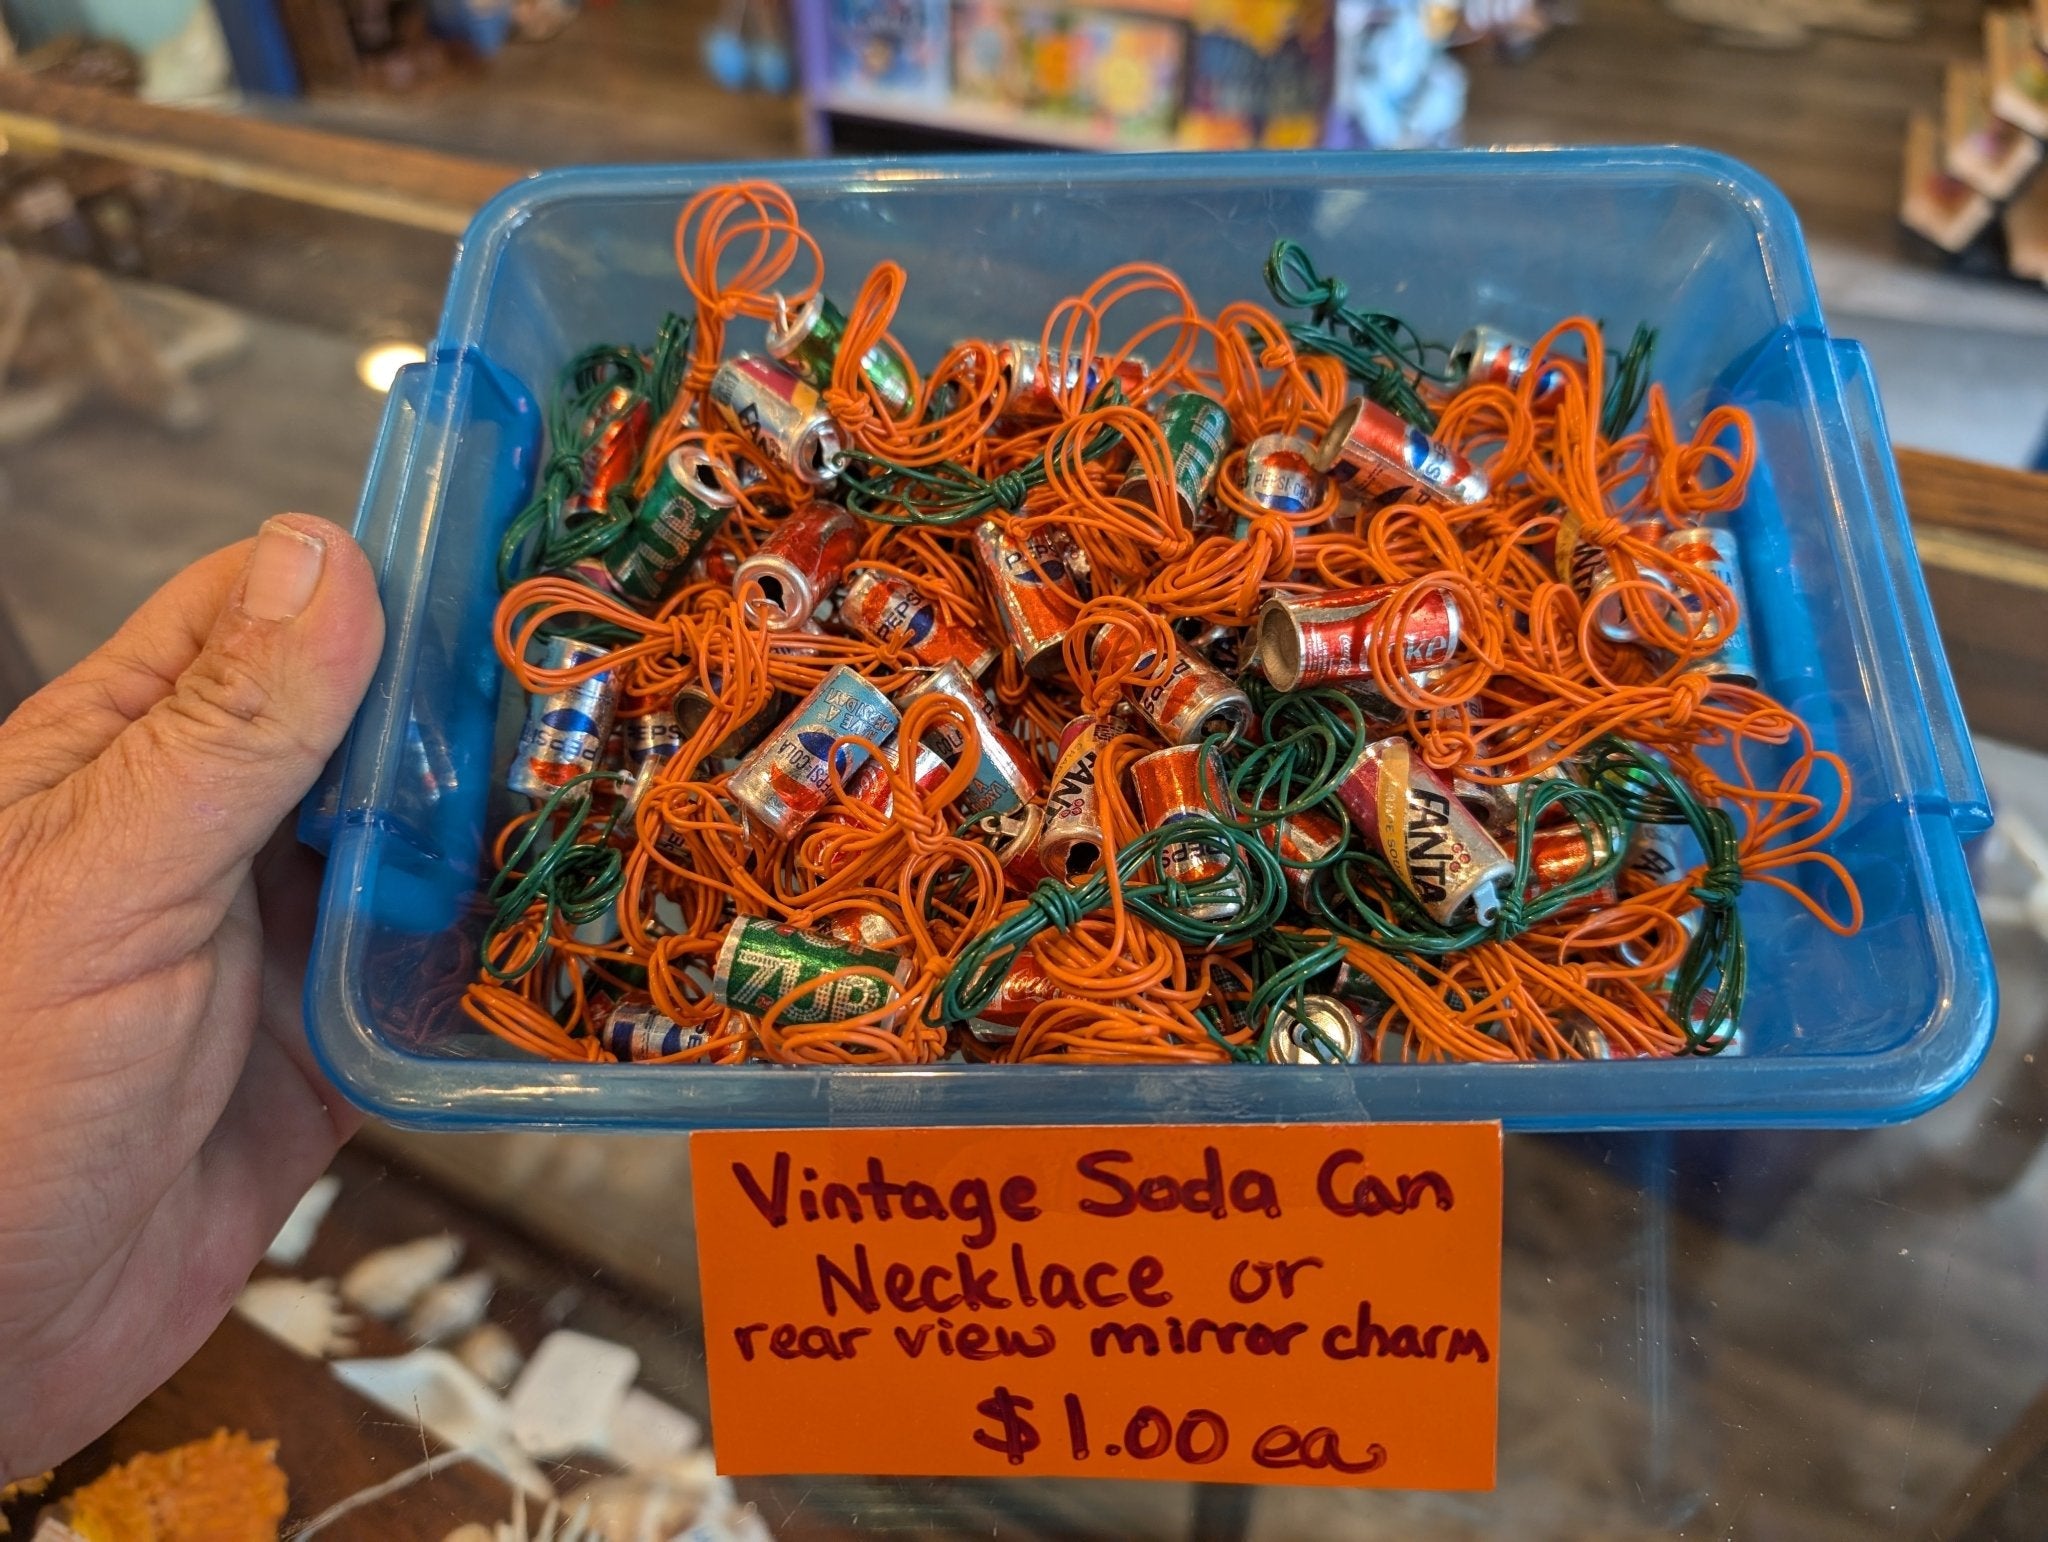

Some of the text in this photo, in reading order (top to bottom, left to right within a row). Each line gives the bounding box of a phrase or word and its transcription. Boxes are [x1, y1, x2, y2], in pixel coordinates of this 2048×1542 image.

[616, 495, 702, 598] 7UP
[1408, 788, 1454, 902] FANTA
[731, 949, 881, 1022] 7UP
[731, 1146, 1455, 1250] Vintage Soda Can
[816, 1243, 1324, 1317] Necklace or
[734, 1300, 1491, 1365] rear view mirror charm
[973, 1386, 1387, 1474] $1.00 ea
